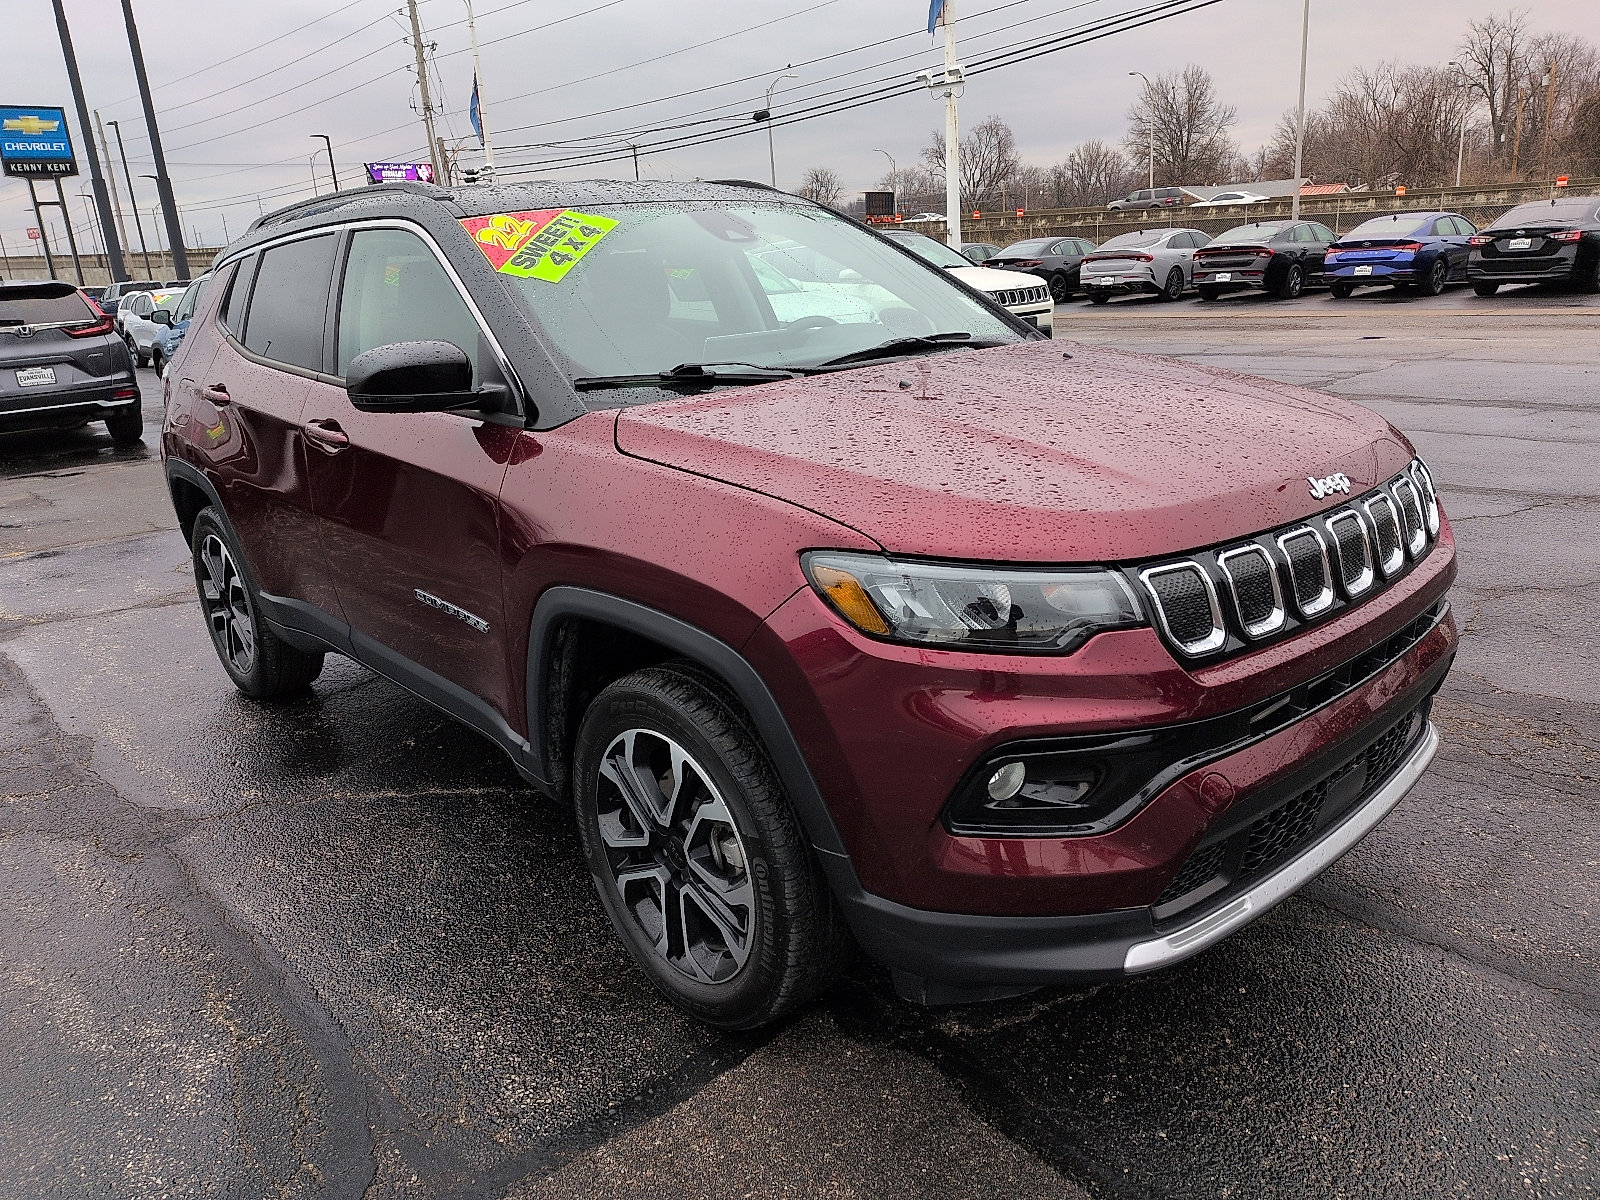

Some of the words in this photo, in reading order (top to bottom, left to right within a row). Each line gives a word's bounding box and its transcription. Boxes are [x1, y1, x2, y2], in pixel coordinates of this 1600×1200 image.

[5, 142, 65, 151] CHEVROLET
[10, 163, 42, 172] KENNY
[47, 163, 71, 172] KENT
[475, 214, 539, 251] 22
[549, 251, 577, 266] 4
[578, 224, 605, 238] 4
[19, 373, 54, 382] EVANSVILLE
[1307, 472, 1351, 499] Jeep
